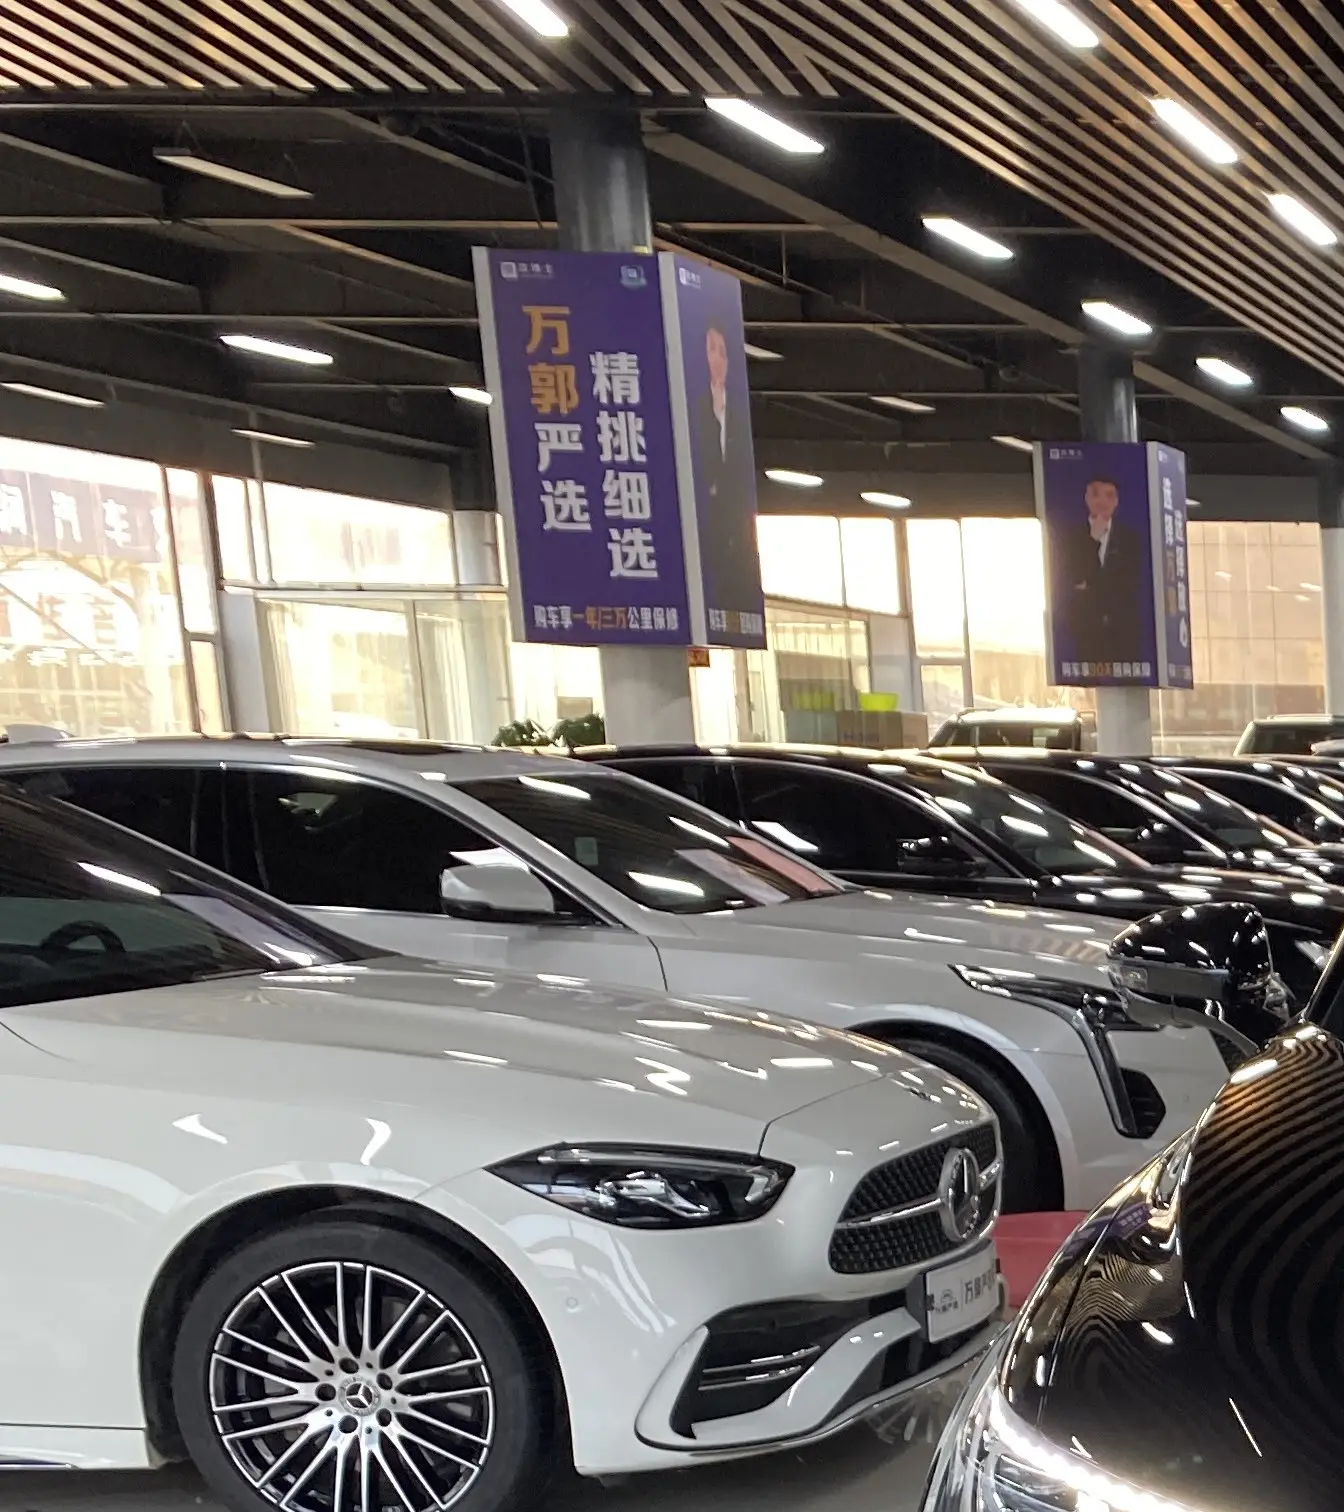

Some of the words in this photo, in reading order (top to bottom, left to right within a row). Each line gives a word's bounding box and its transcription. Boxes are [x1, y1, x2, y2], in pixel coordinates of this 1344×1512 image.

[521, 304, 593, 533] 万郭严选
[589, 350, 659, 579] 精挑细选
